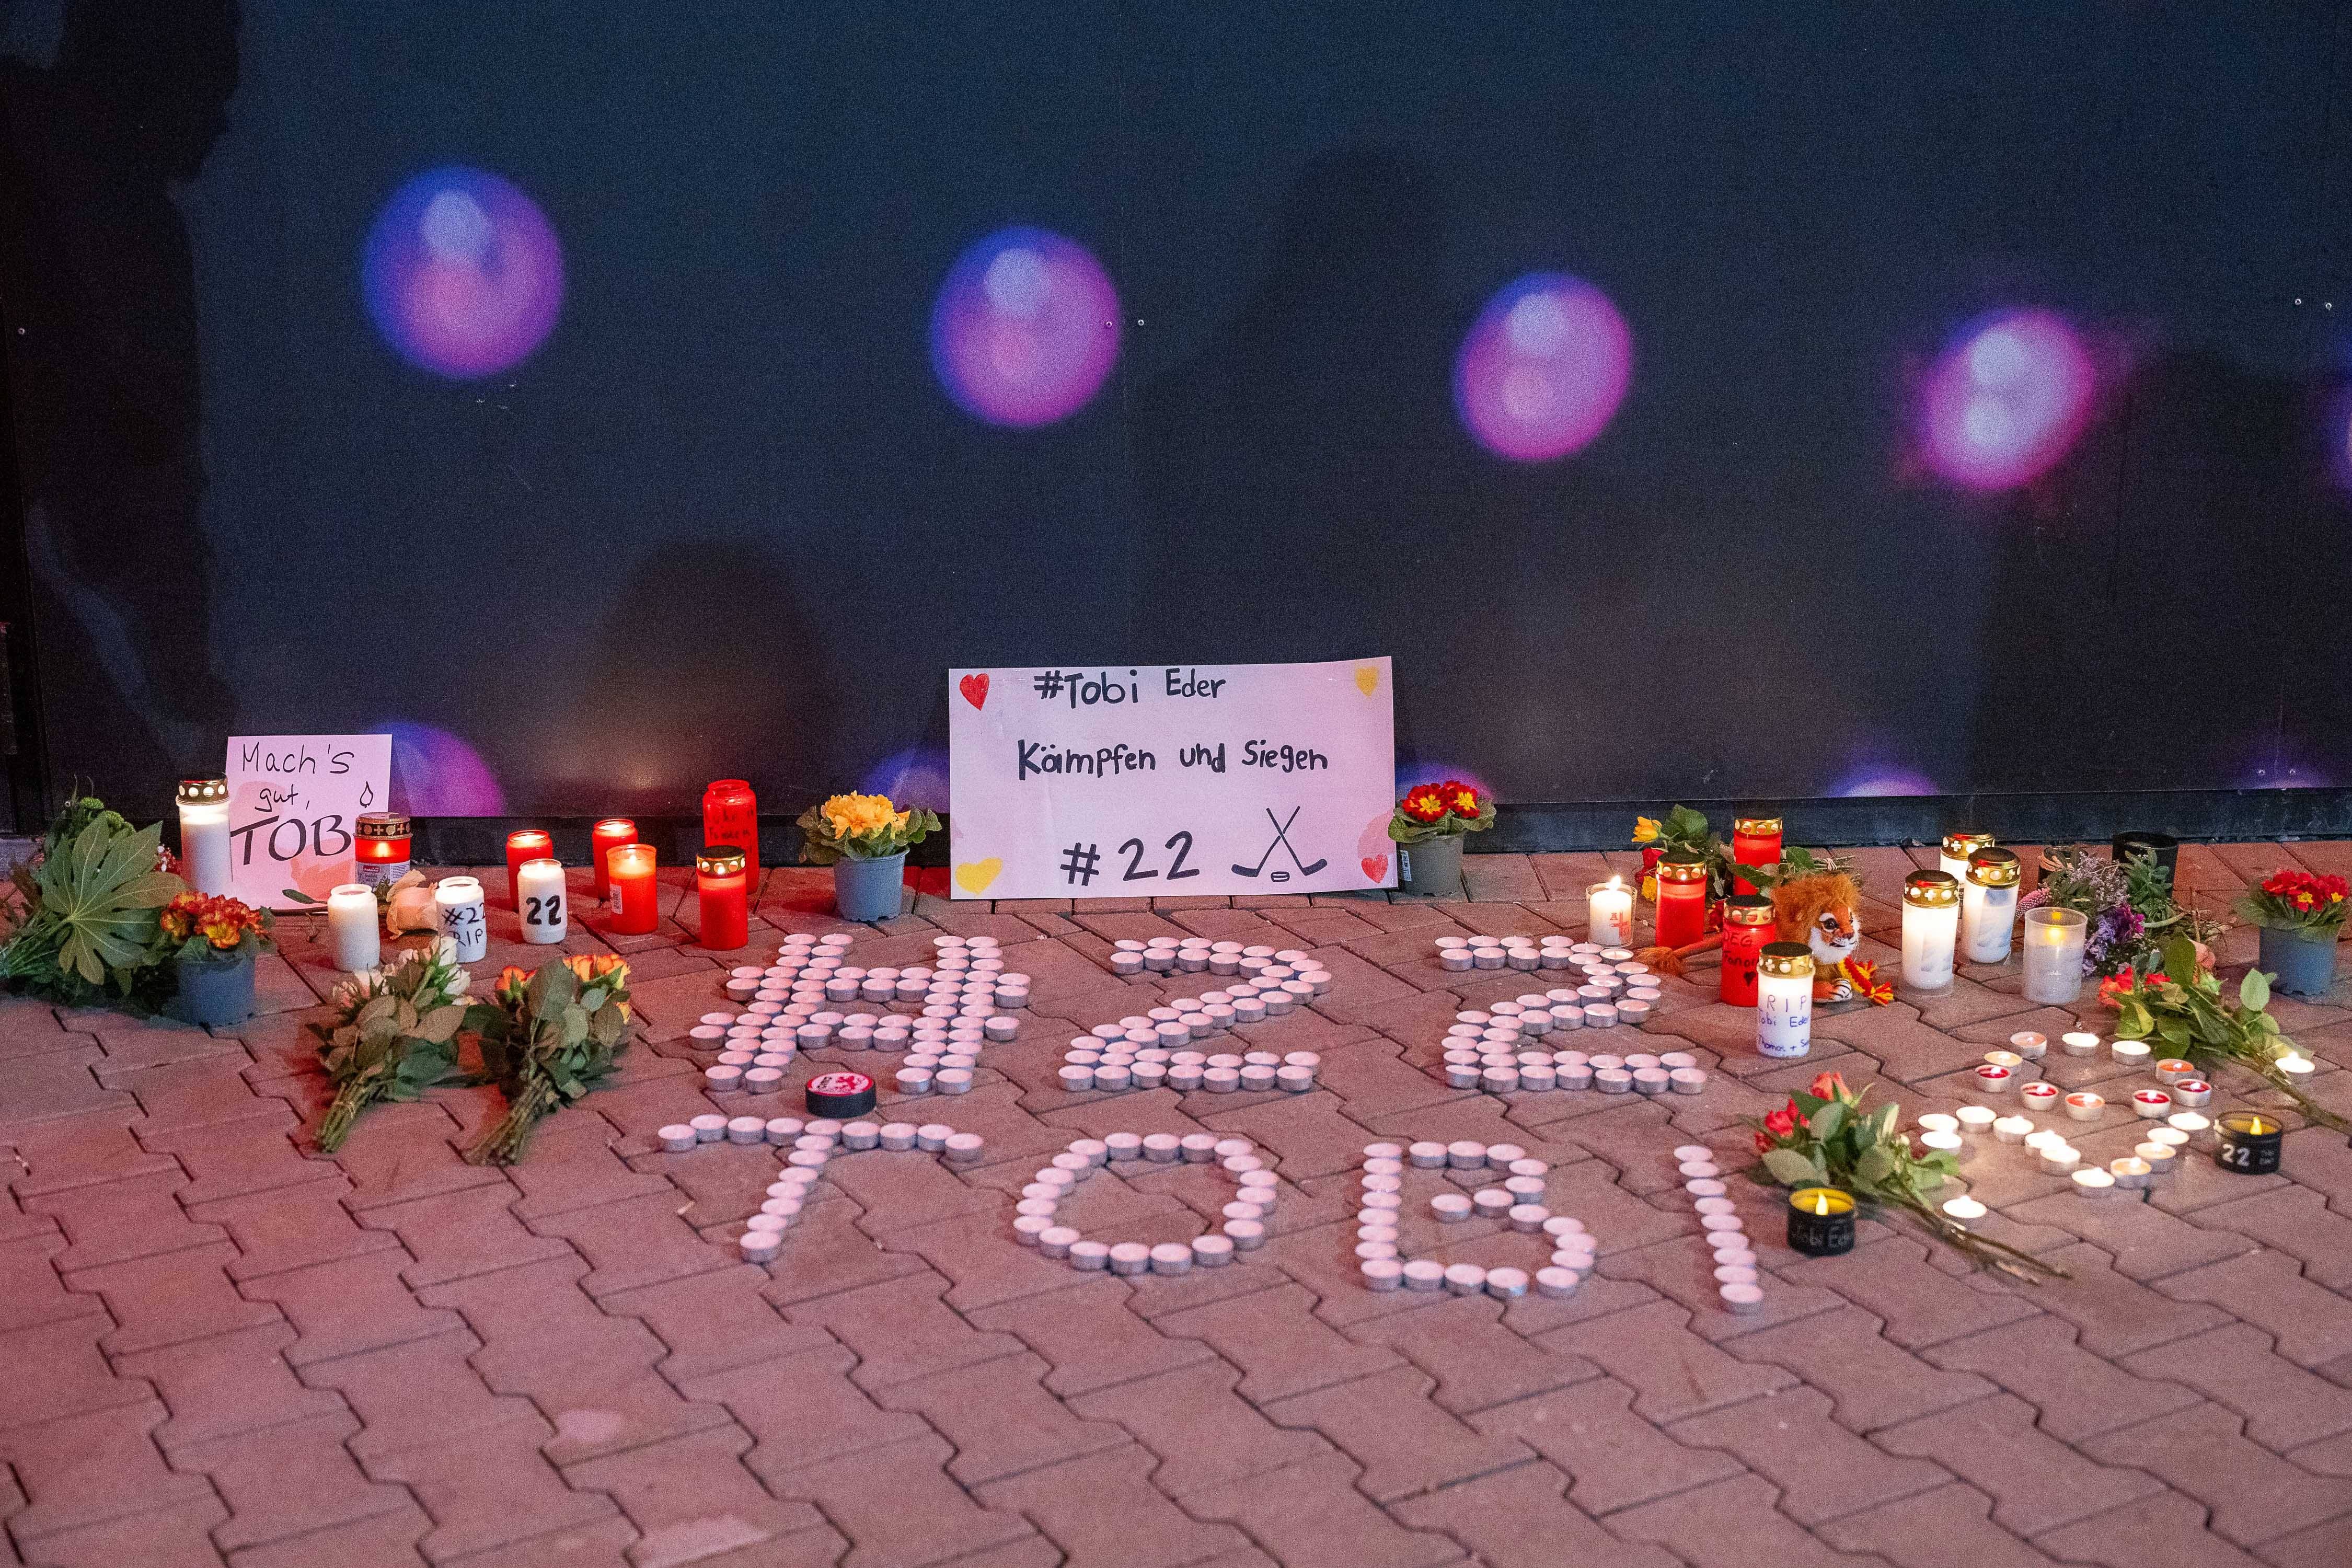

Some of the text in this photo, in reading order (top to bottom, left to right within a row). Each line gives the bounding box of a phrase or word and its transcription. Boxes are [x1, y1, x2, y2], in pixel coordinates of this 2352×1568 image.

[1033, 667, 1227, 709] #Tobi Eder
[242, 741, 355, 774] Mach's
[1017, 739, 1329, 781] Kämpfen und Siegen
[255, 783, 310, 813] gut,
[526, 895, 562, 926] 22
[448, 928, 483, 947] RIP
[2222, 1143, 2251, 1167] 22
